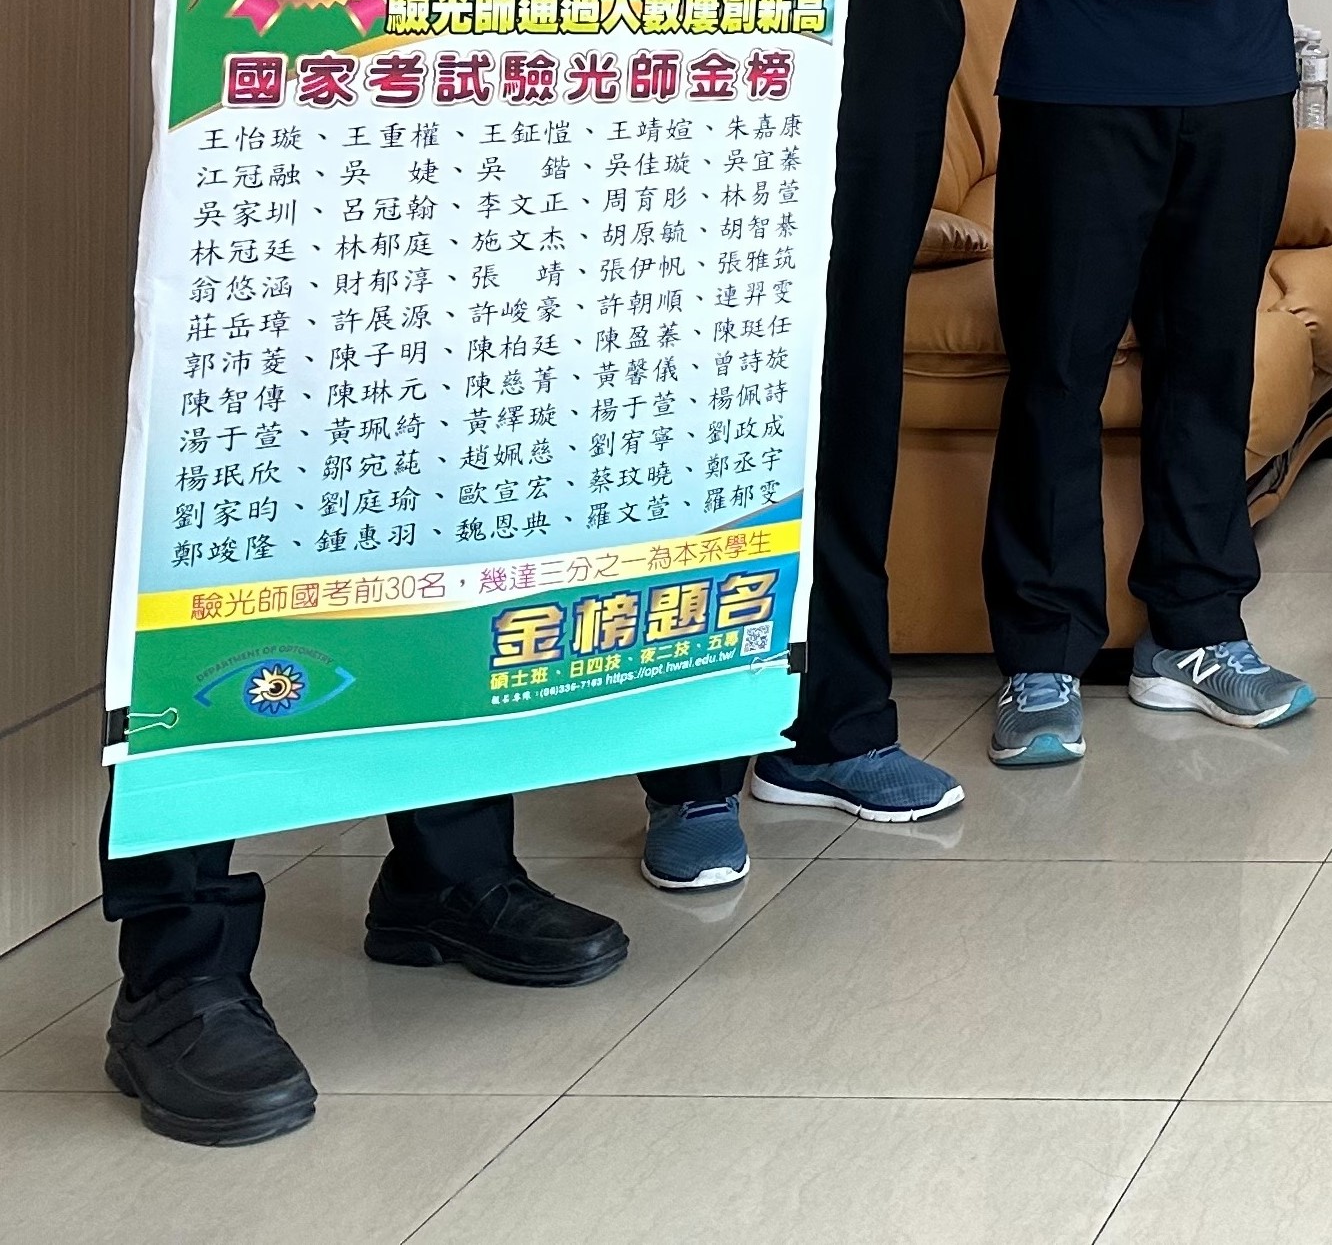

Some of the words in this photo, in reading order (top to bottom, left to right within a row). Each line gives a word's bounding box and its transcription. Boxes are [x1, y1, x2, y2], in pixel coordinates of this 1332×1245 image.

[224, 53, 795, 106] 國家考試驗光師金榜
[490, 569, 780, 669] 金榜題名
